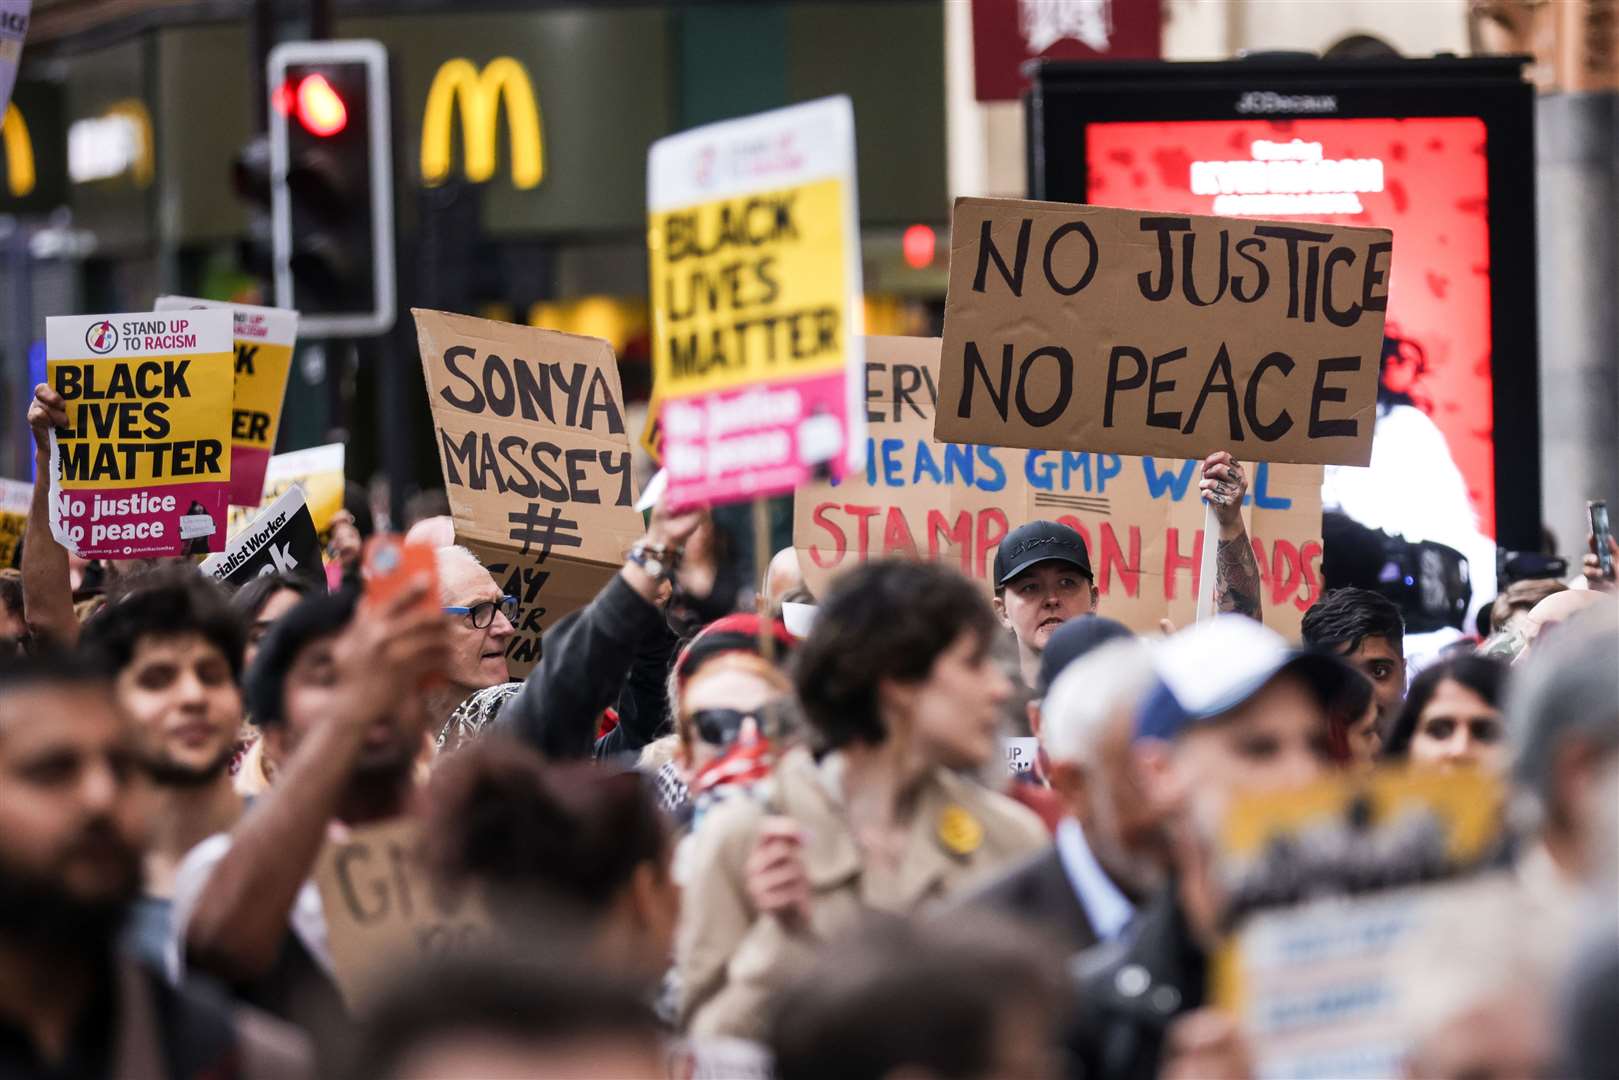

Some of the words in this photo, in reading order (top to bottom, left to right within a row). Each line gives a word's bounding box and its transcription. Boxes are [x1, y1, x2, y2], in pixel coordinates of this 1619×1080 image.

[664, 196, 802, 263] BLACK
[665, 256, 782, 323] LIVES
[972, 219, 1099, 297] NO
[1137, 218, 1392, 327] JUSTICE
[122, 320, 166, 336] STAND
[170, 320, 189, 334] UP
[123, 337, 141, 350] TO
[145, 334, 196, 350] RACISM
[670, 305, 842, 383] MATTER
[55, 360, 192, 400] BLACK
[440, 345, 625, 434] SONYA
[957, 341, 1073, 427] NO
[1103, 342, 1361, 441] PEACE
[58, 439, 223, 481] MATTER
[441, 427, 632, 506] MASSEY
[1024, 448, 1122, 494] GMP
[91, 491, 176, 521] justice
[91, 521, 164, 546] peace
[508, 503, 582, 564] #
[203, 511, 287, 581] cialistWorker
[808, 502, 1009, 579] STAMP
